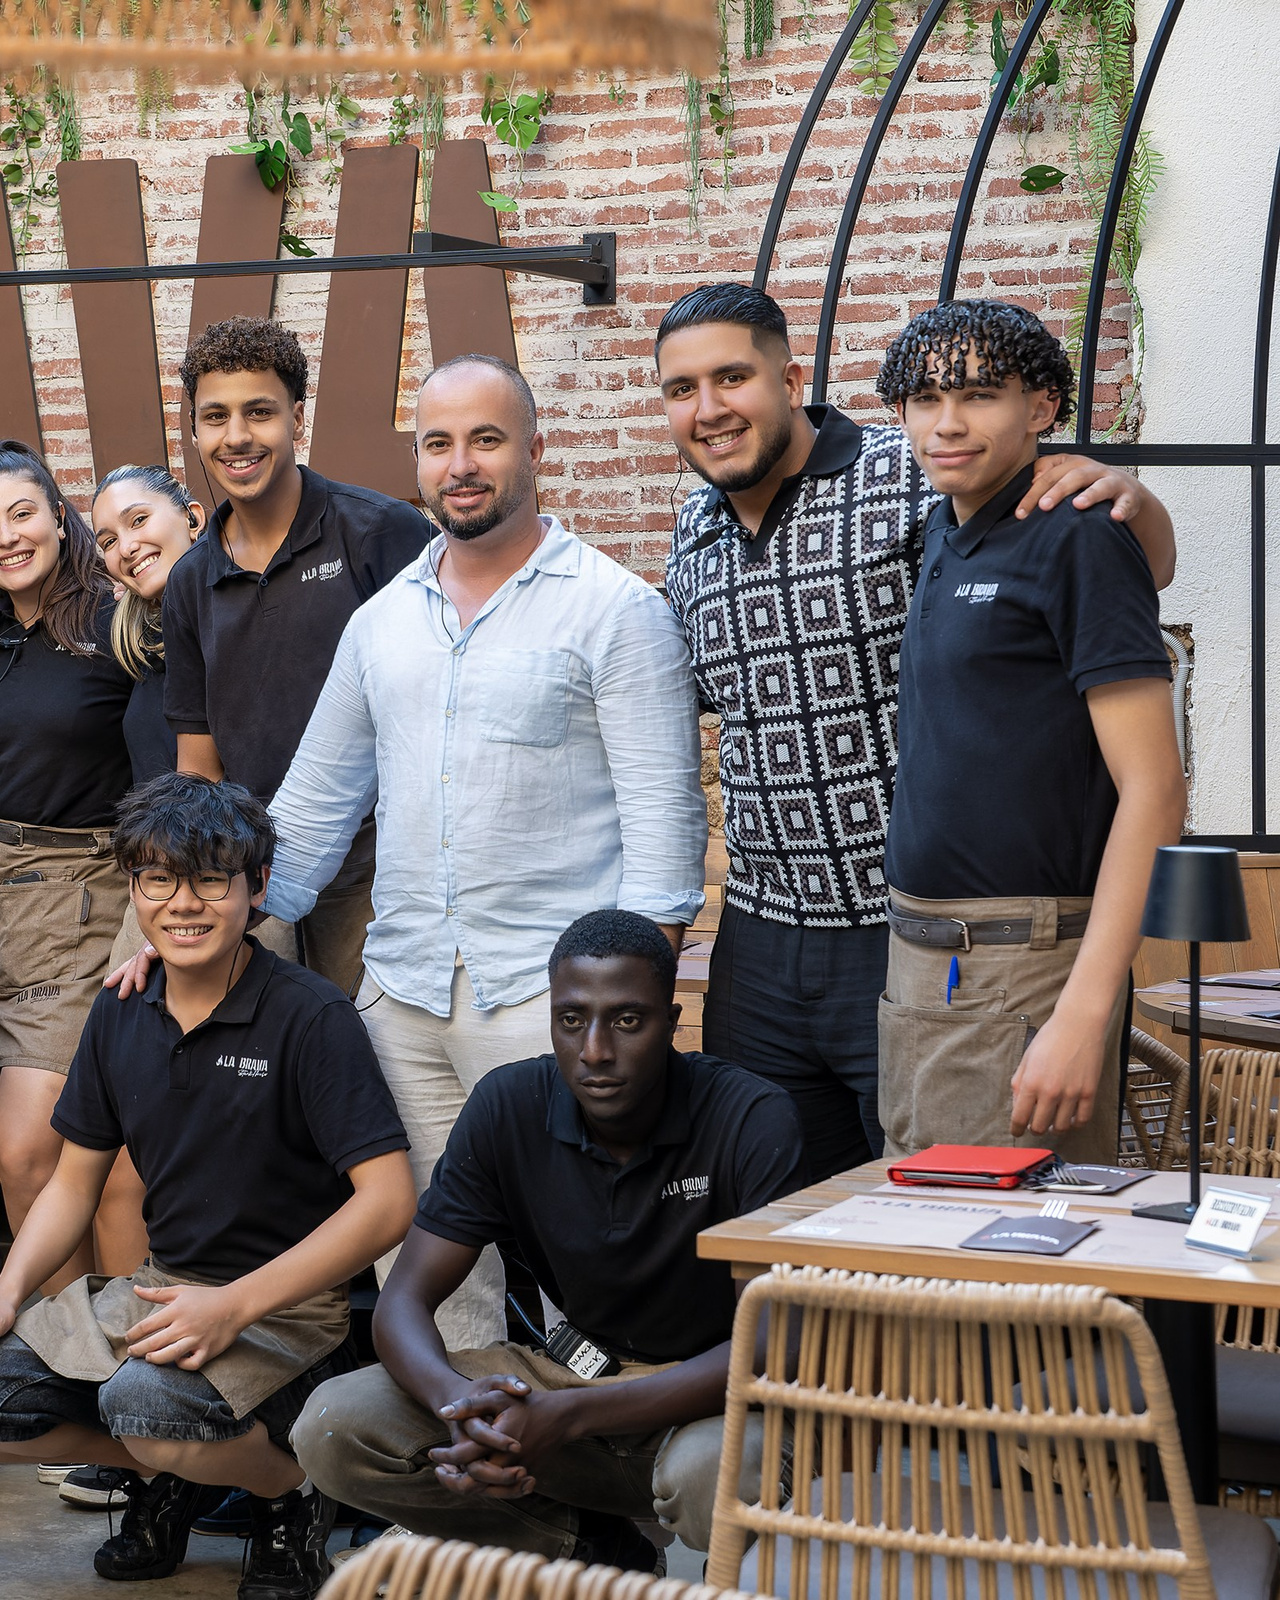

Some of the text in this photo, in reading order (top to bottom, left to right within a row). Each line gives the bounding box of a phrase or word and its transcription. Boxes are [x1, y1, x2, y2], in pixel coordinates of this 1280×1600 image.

[960, 583, 972, 597] LA
[30, 985, 61, 998] BRAVA
[223, 1056, 268, 1072] LA BRAVA
[667, 1181, 681, 1195] LA
